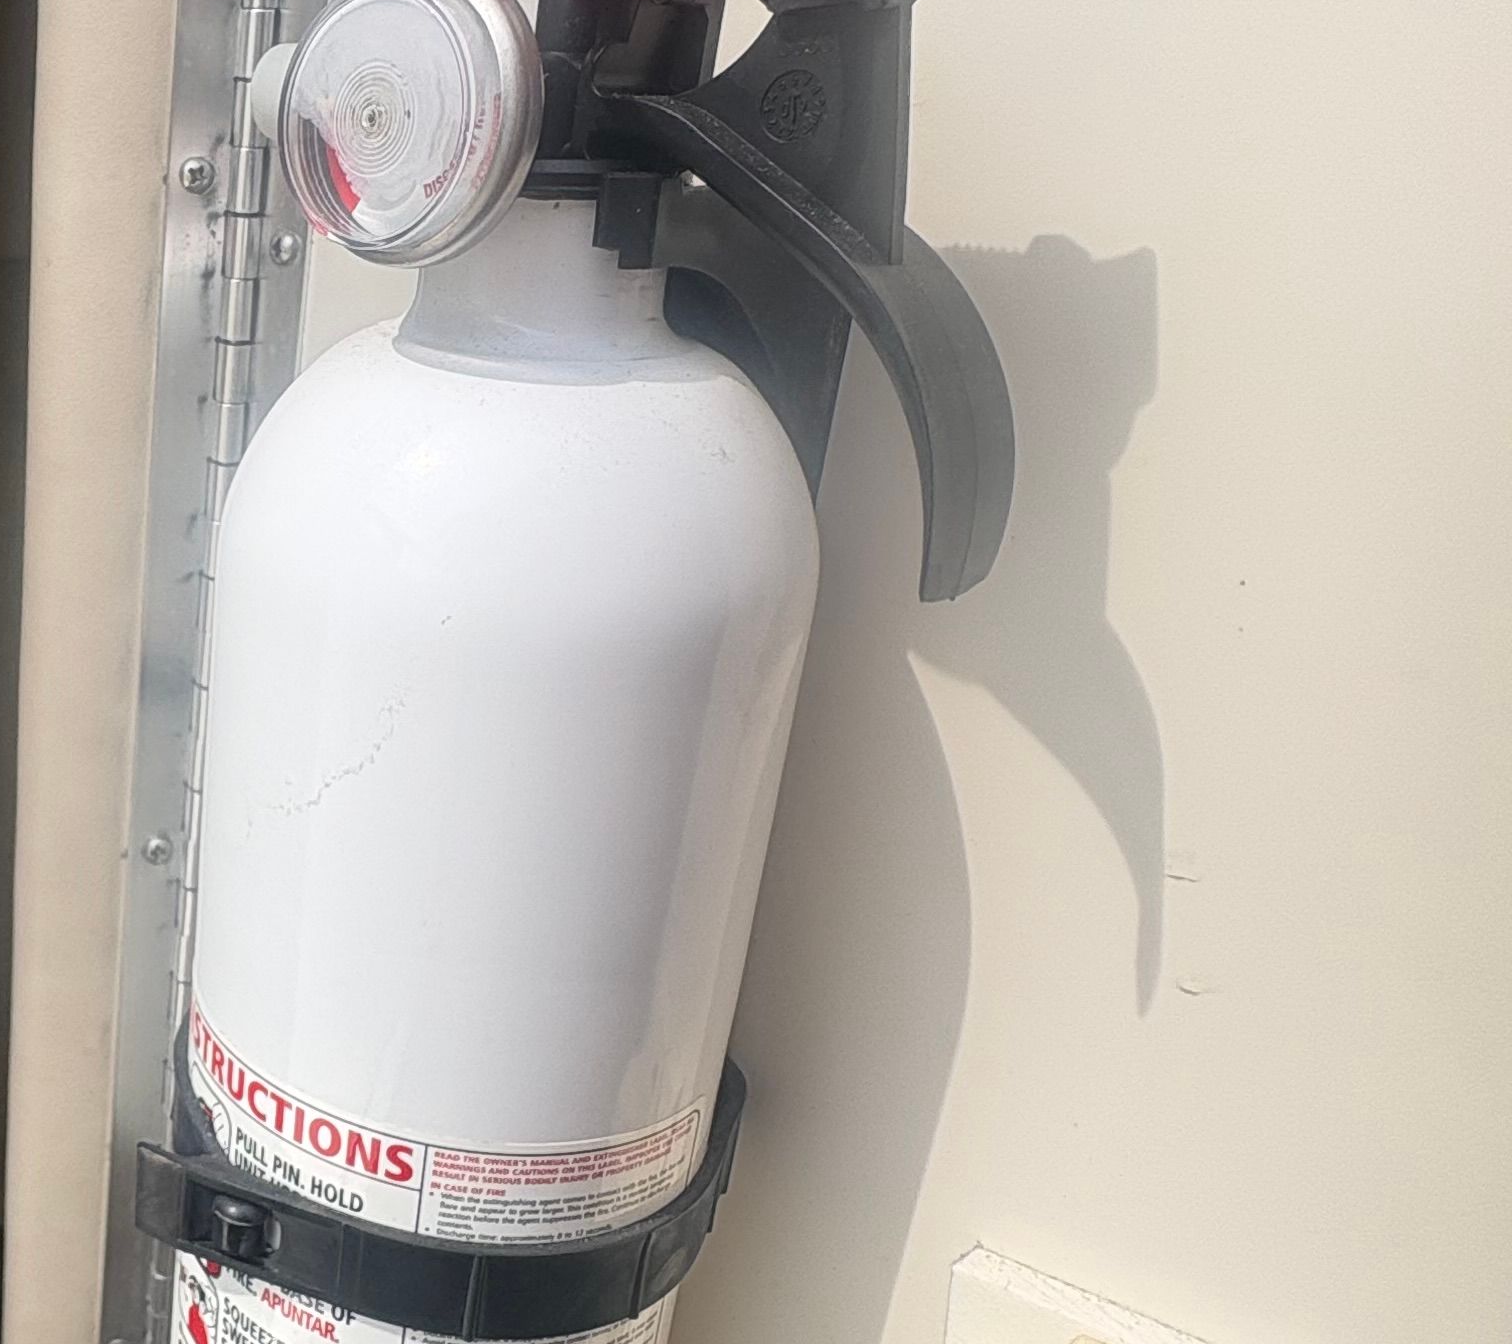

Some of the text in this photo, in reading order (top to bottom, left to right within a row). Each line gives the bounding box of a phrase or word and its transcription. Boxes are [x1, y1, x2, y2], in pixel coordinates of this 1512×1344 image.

[236, 1126, 364, 1212] PULL PIN. HOLD
[482, 1176, 522, 1185] SERIOUS
[430, 1181, 441, 1190] IN
[443, 1183, 468, 1194] CASE
[470, 1187, 483, 1195] OF
[261, 1287, 339, 1344] APUNTAR.
